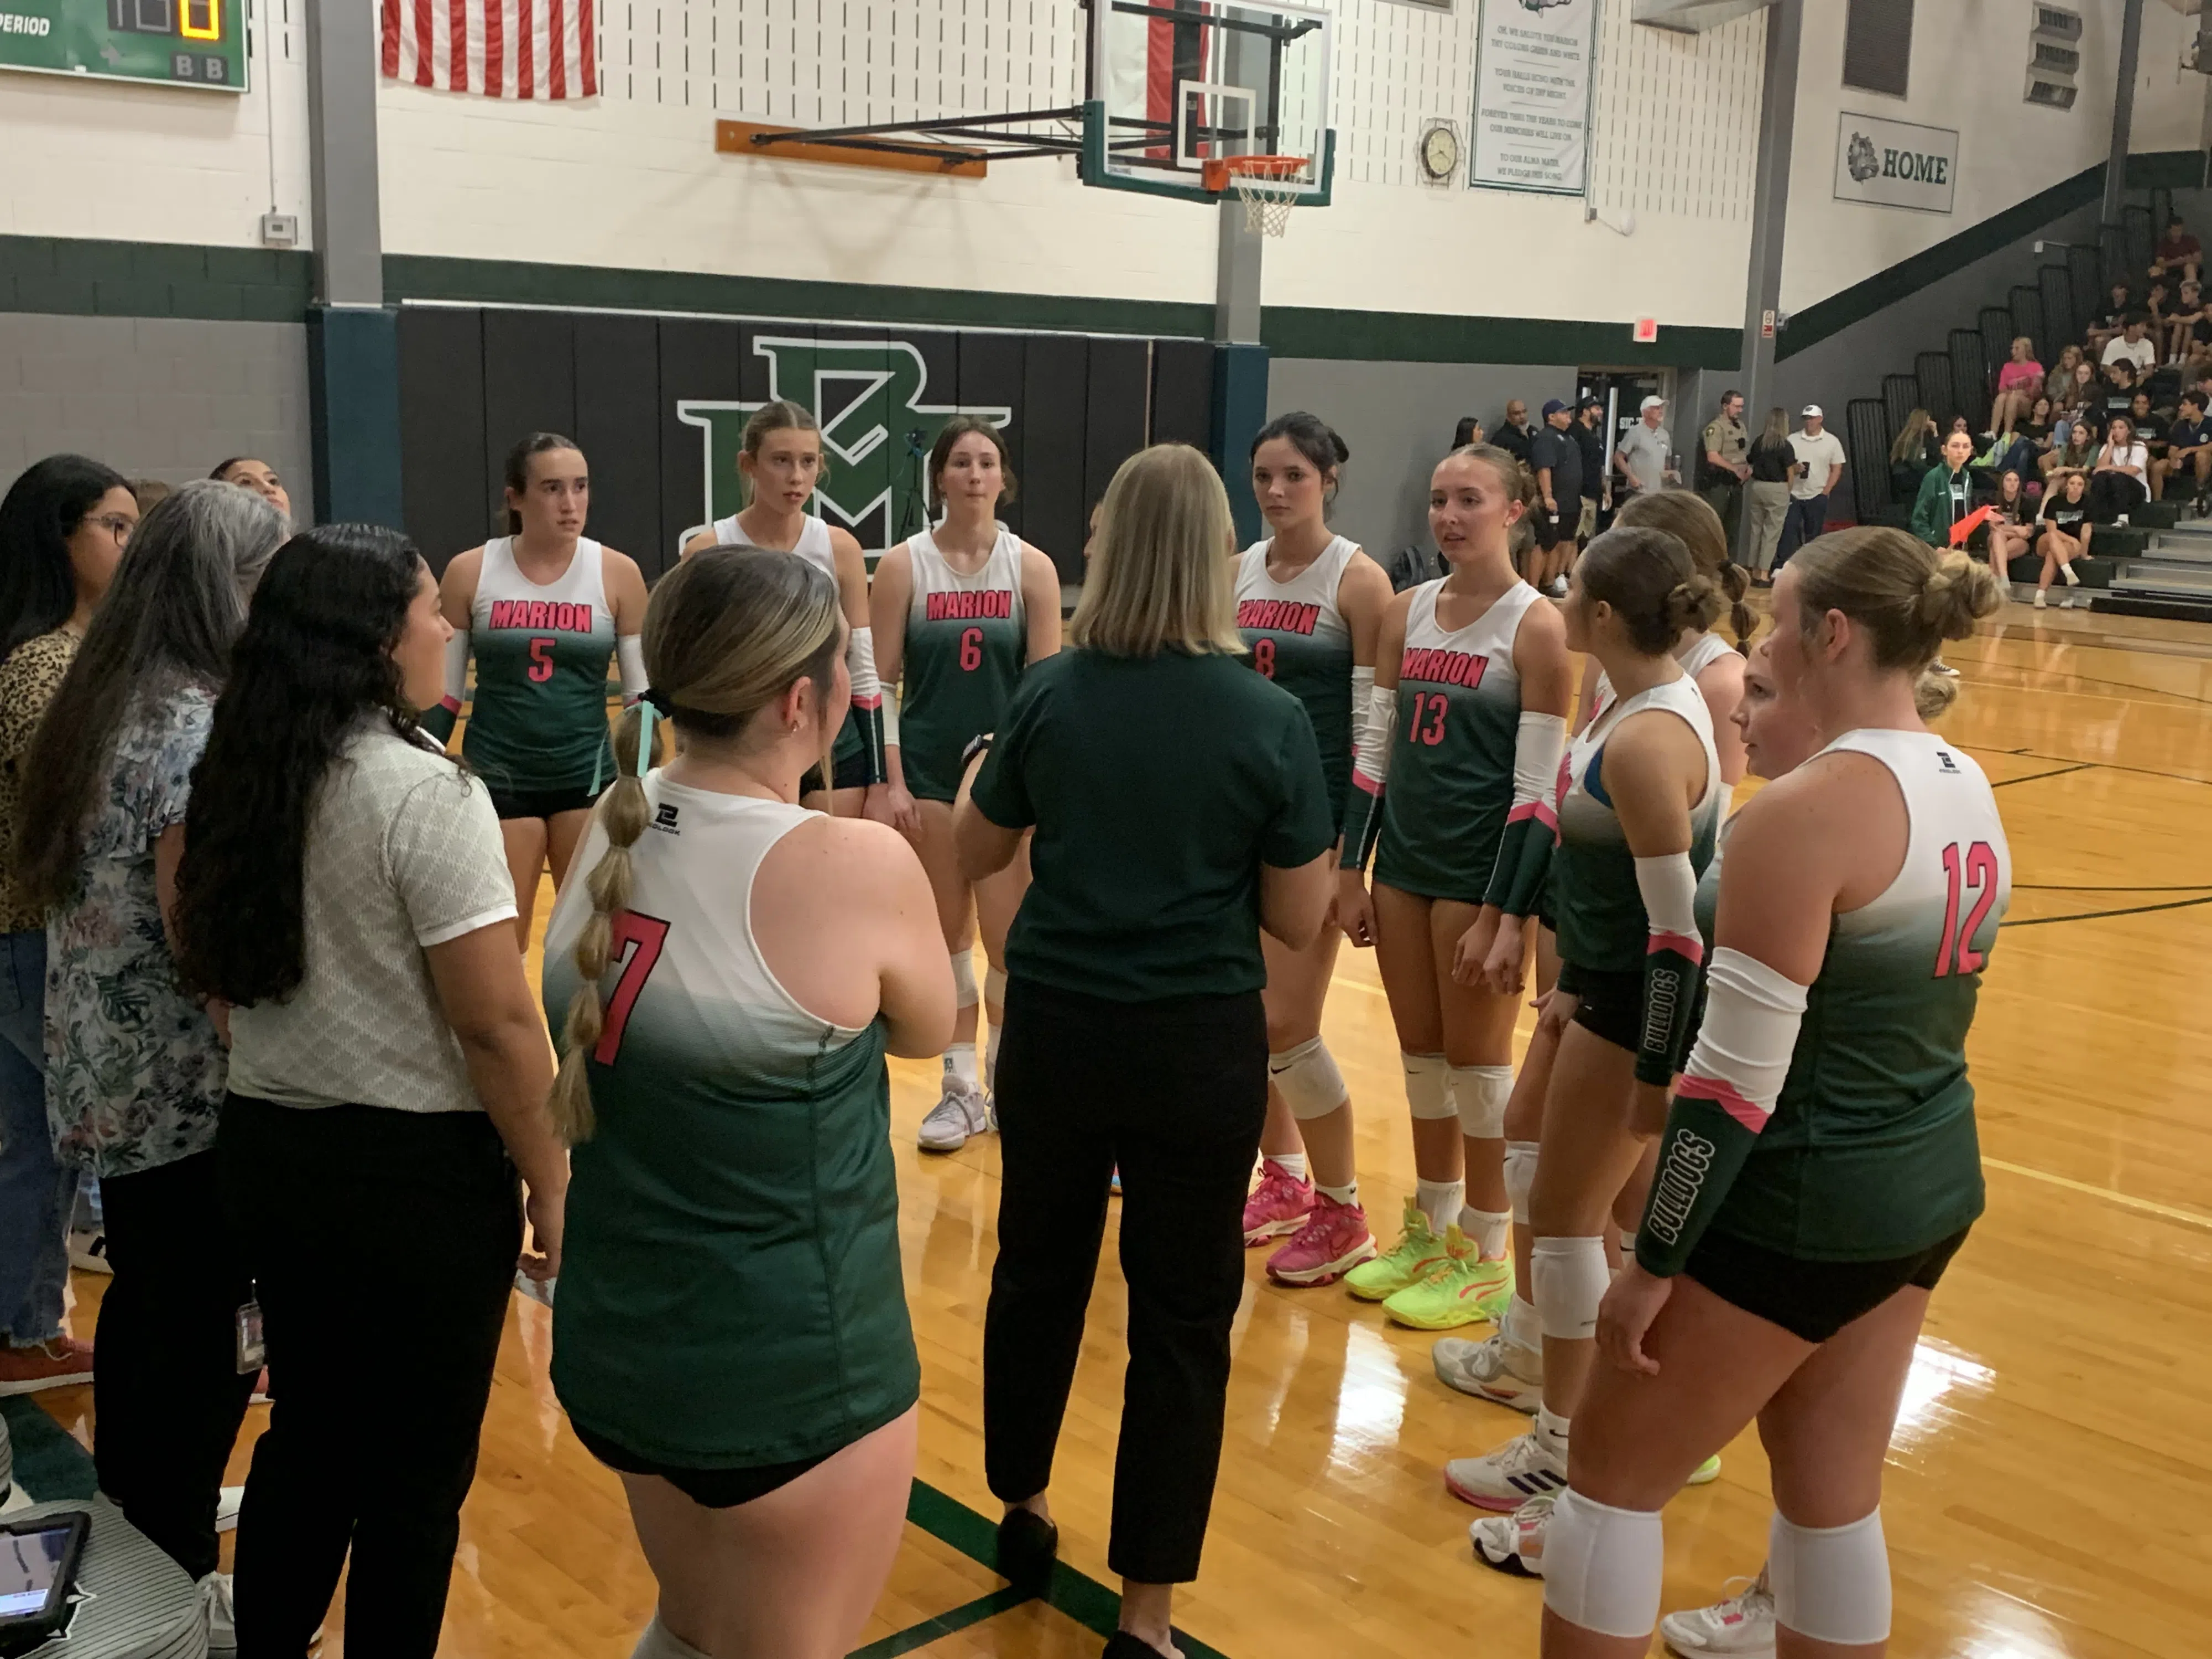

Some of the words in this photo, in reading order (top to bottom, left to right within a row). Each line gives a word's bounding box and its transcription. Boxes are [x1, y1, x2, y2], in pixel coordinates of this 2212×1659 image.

[1882, 148, 1948, 185] HOME
[489, 599, 592, 633] MARION
[927, 590, 1012, 621] MARION
[1237, 599, 1321, 636] MARION
[528, 638, 557, 682] 5
[959, 627, 983, 671] 6
[1254, 637, 1277, 680] 8
[1399, 648, 1489, 690] MARION
[1409, 691, 1449, 745] 13
[1932, 841, 1998, 979] 12
[594, 908, 671, 1066] 7
[1647, 1128, 1715, 1246] BULLDOGS
